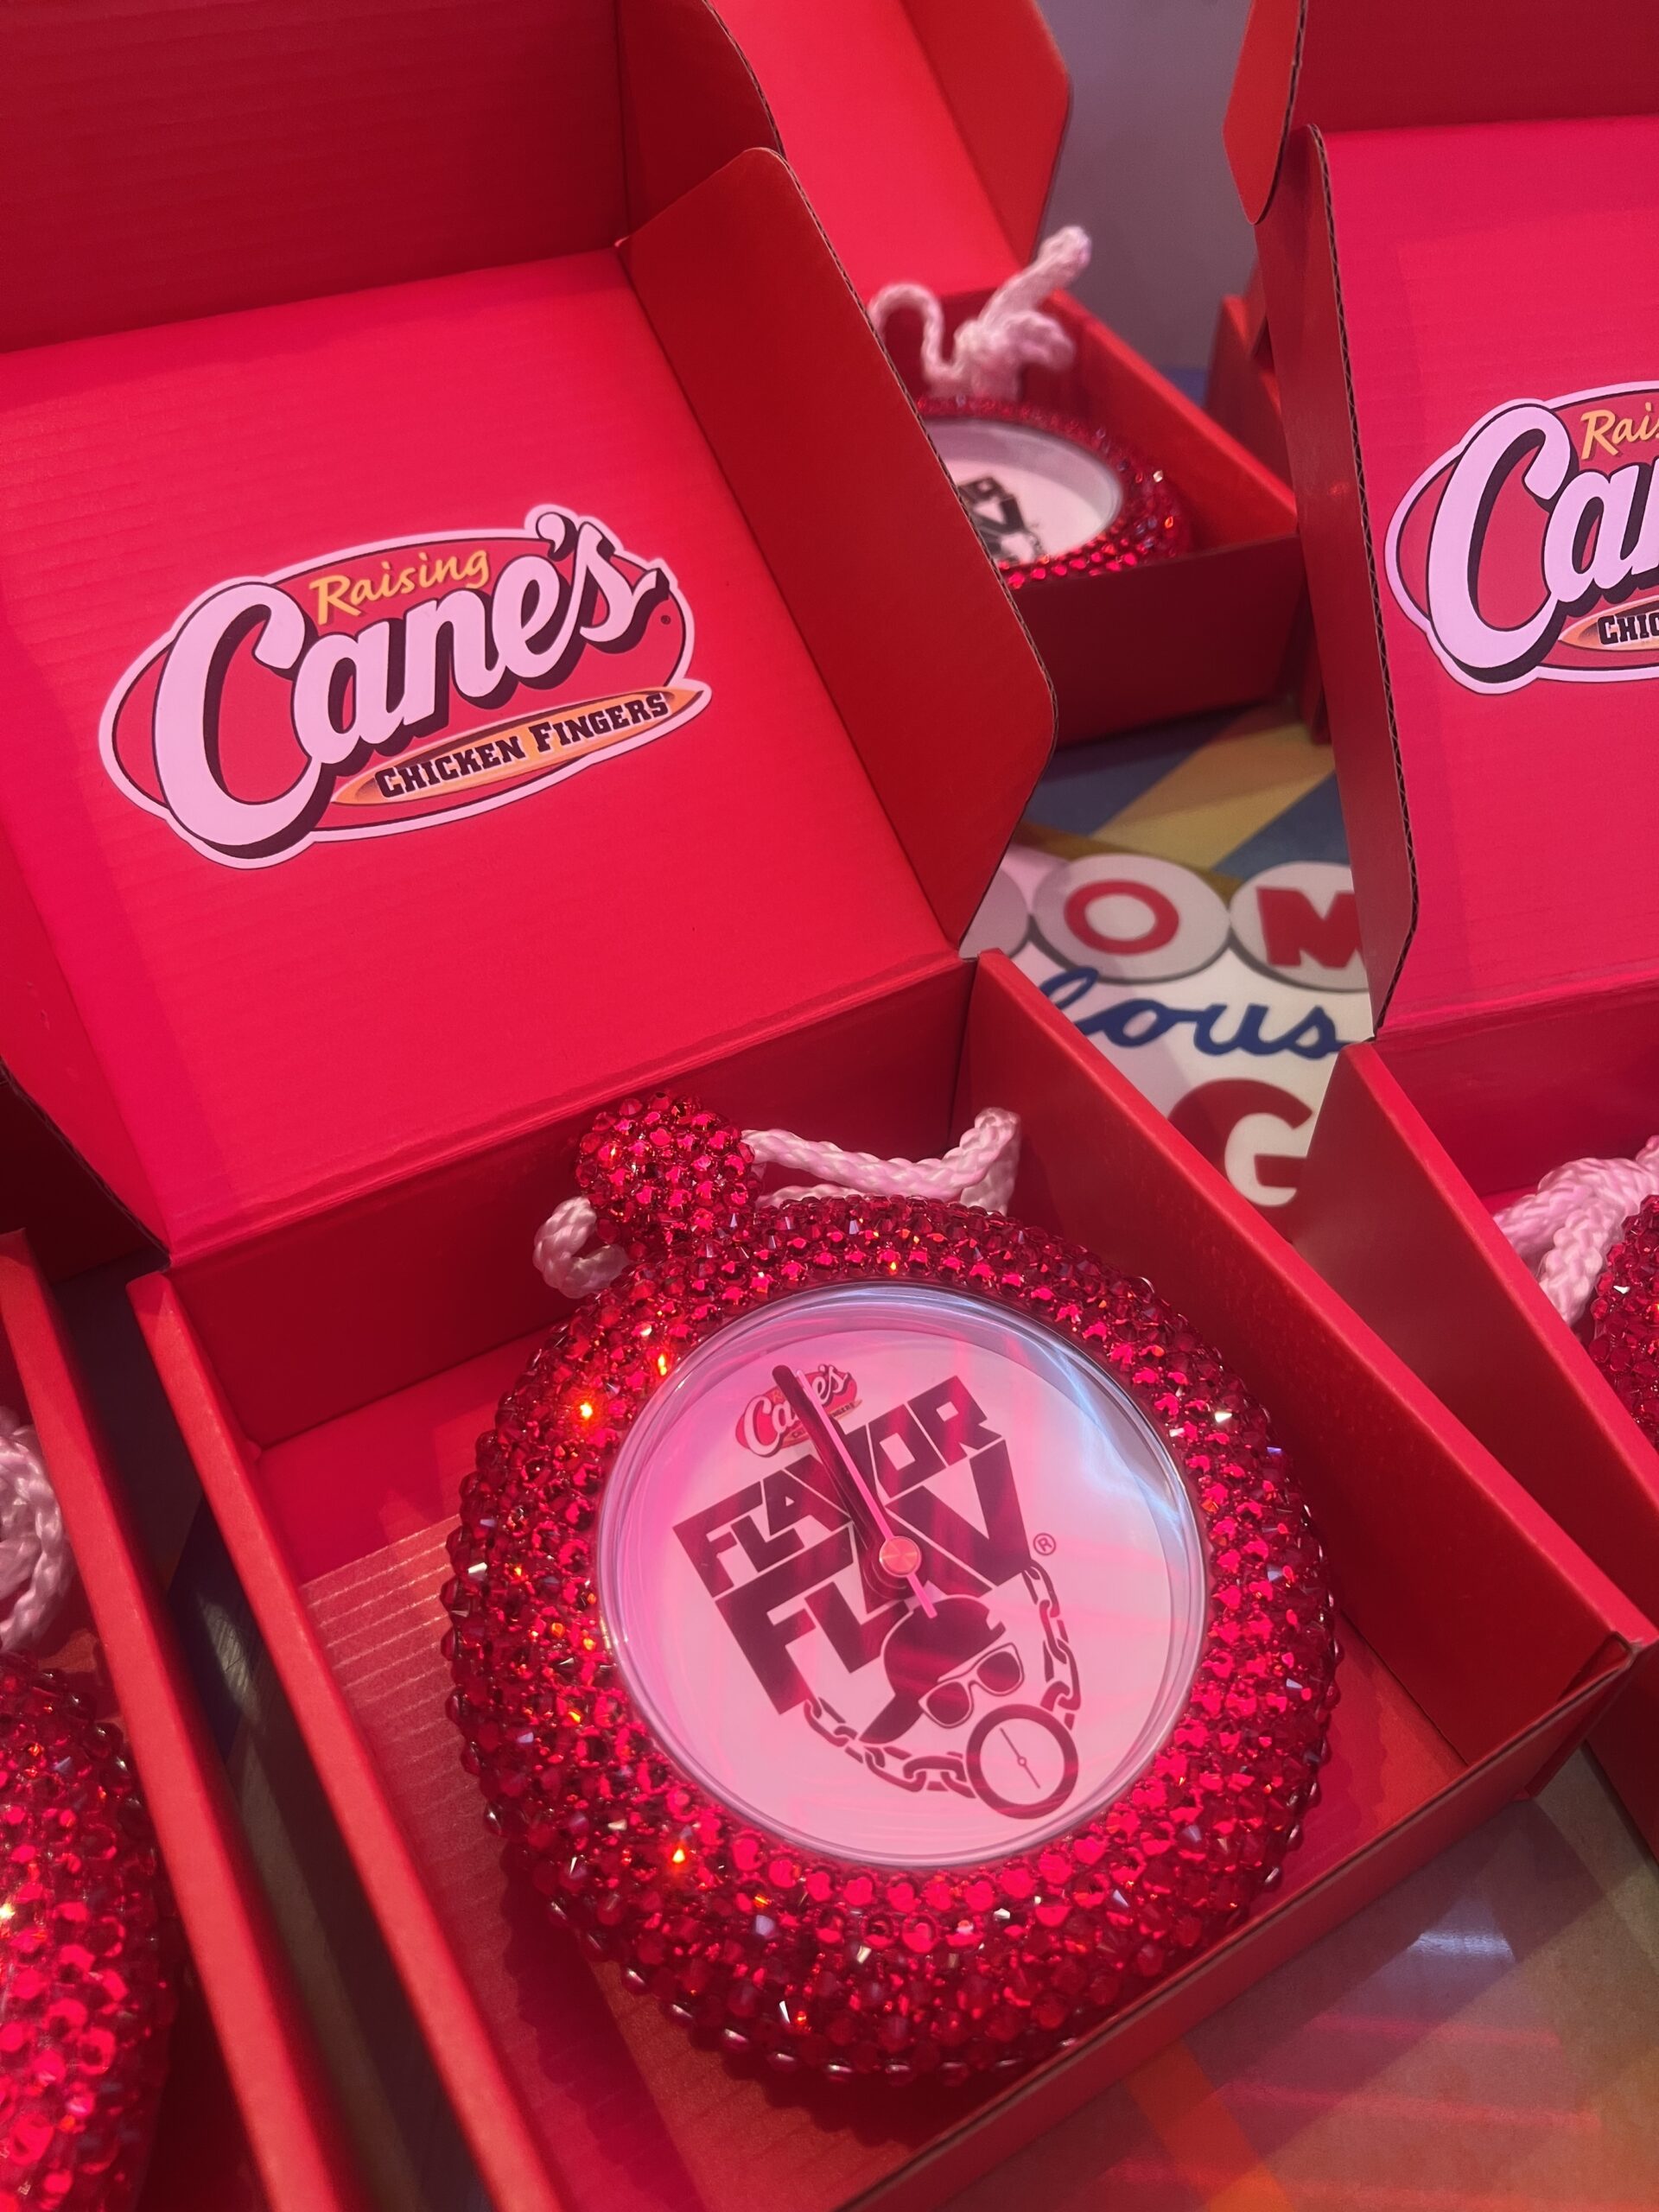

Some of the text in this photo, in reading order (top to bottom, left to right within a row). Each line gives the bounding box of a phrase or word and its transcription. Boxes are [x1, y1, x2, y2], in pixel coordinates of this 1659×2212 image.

[1580, 402, 1659, 460] Rai
[308, 550, 489, 626] Raising
[1426, 403, 1659, 683] Ca
[155, 512, 670, 859] Cane's
[374, 693, 670, 798] CHICKEN FINGERS
[743, 1363, 852, 1458] Cae's
